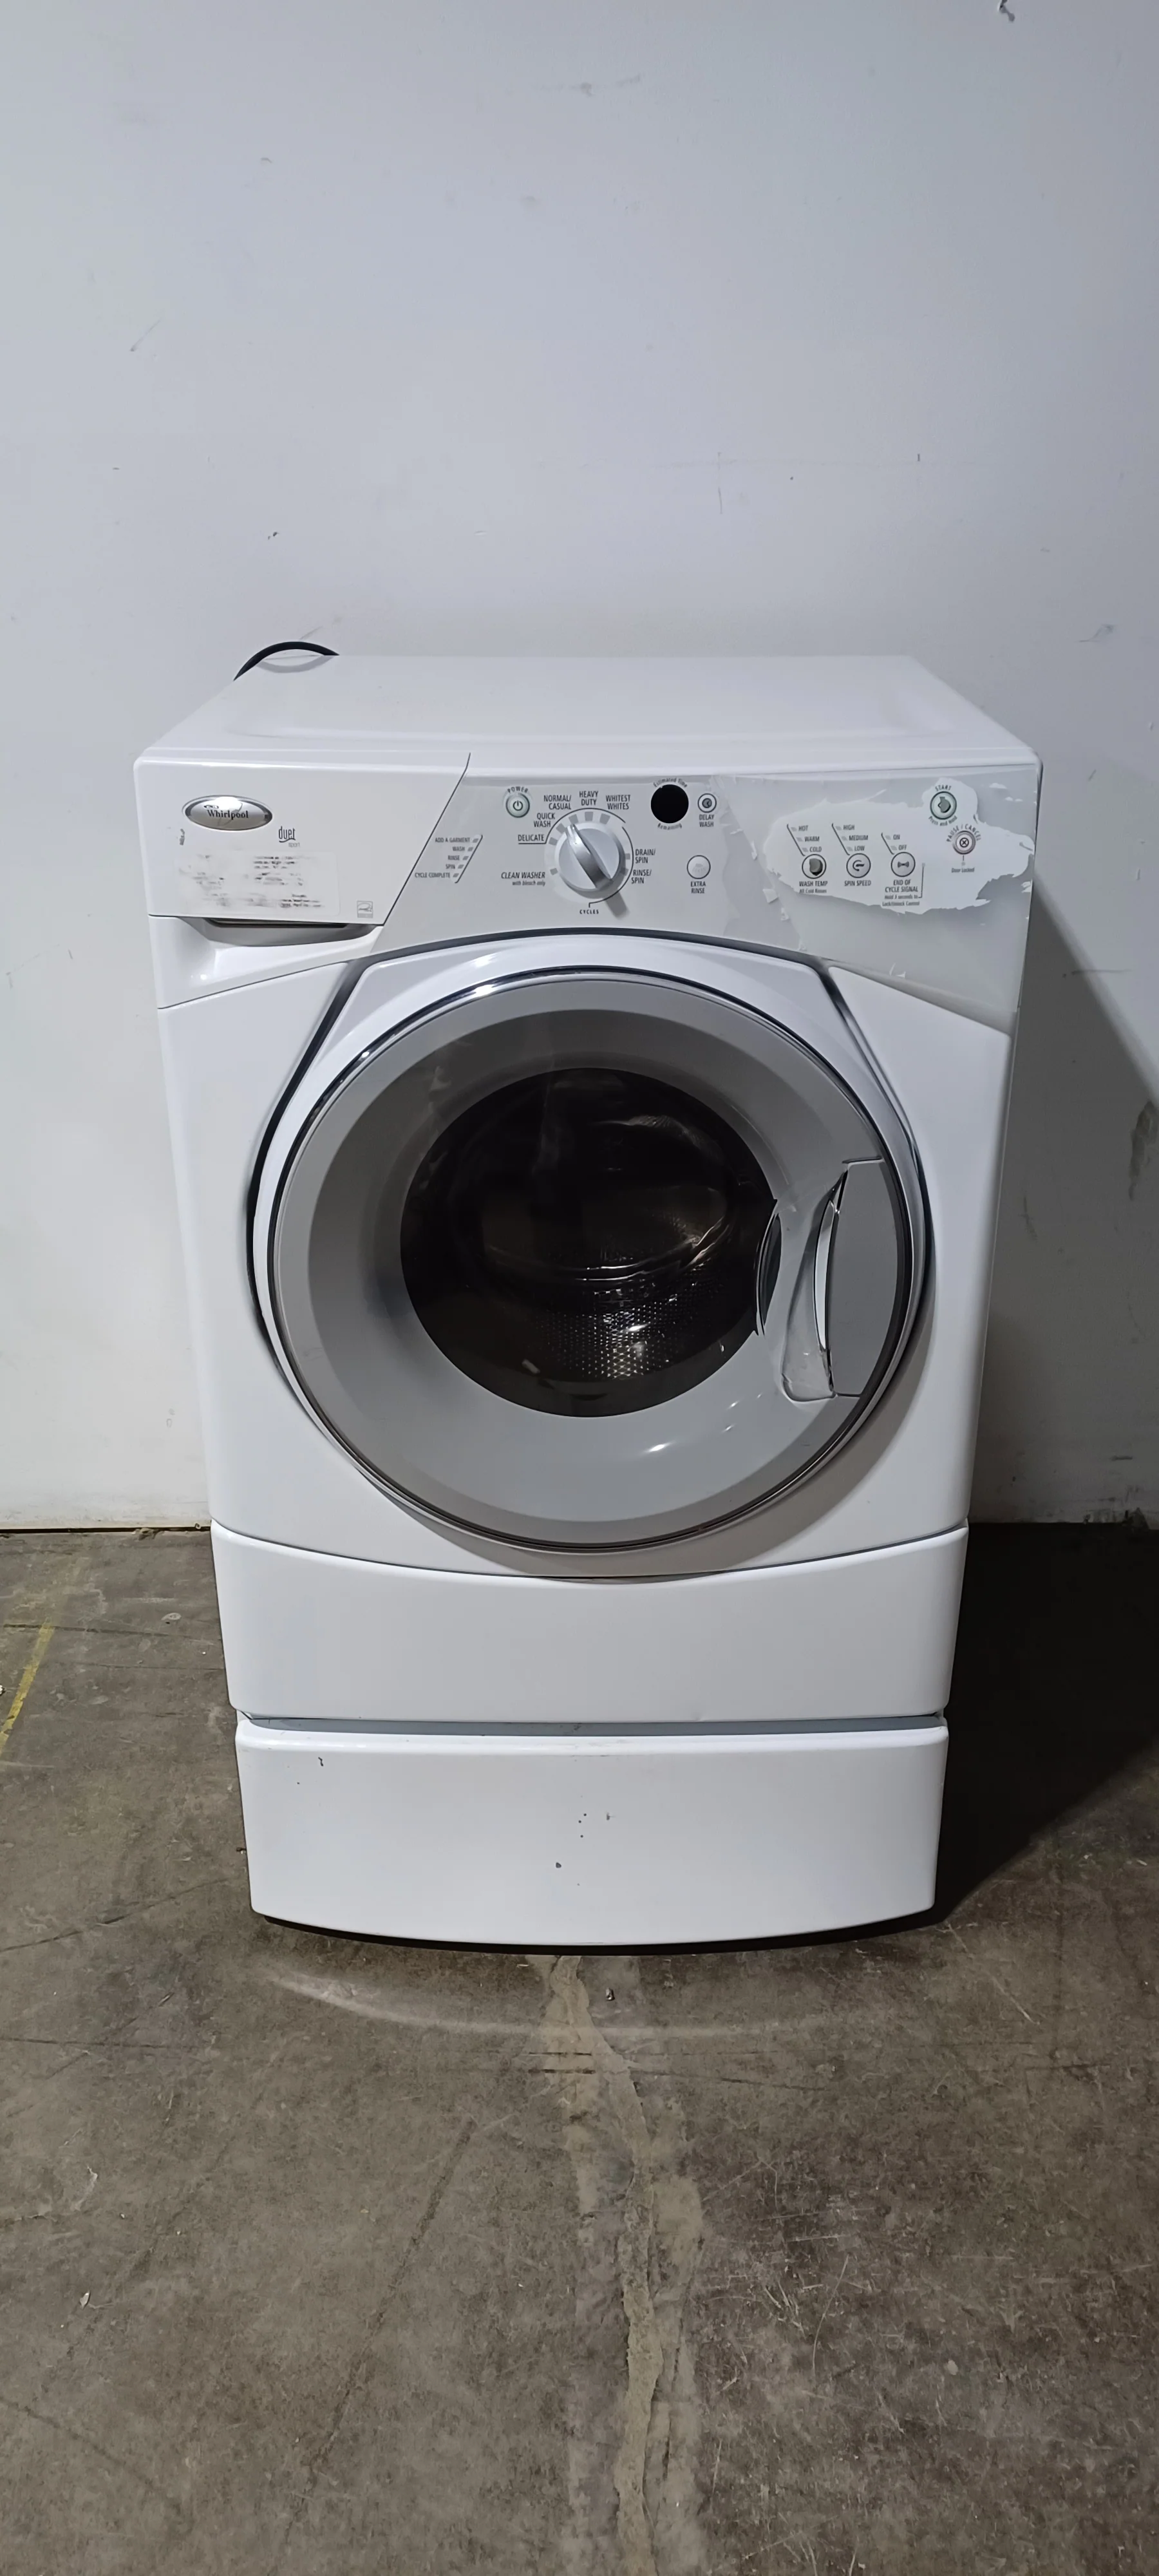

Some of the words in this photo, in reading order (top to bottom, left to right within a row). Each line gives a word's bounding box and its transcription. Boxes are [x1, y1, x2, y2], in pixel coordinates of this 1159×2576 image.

[653, 777, 677, 788] Estimated
[677, 778, 688, 788] Time
[207, 810, 249, 820] Whirlpool
[279, 826, 296, 840] duet
[947, 826, 959, 842] PAUSE
[965, 824, 981, 841] CANCEL
